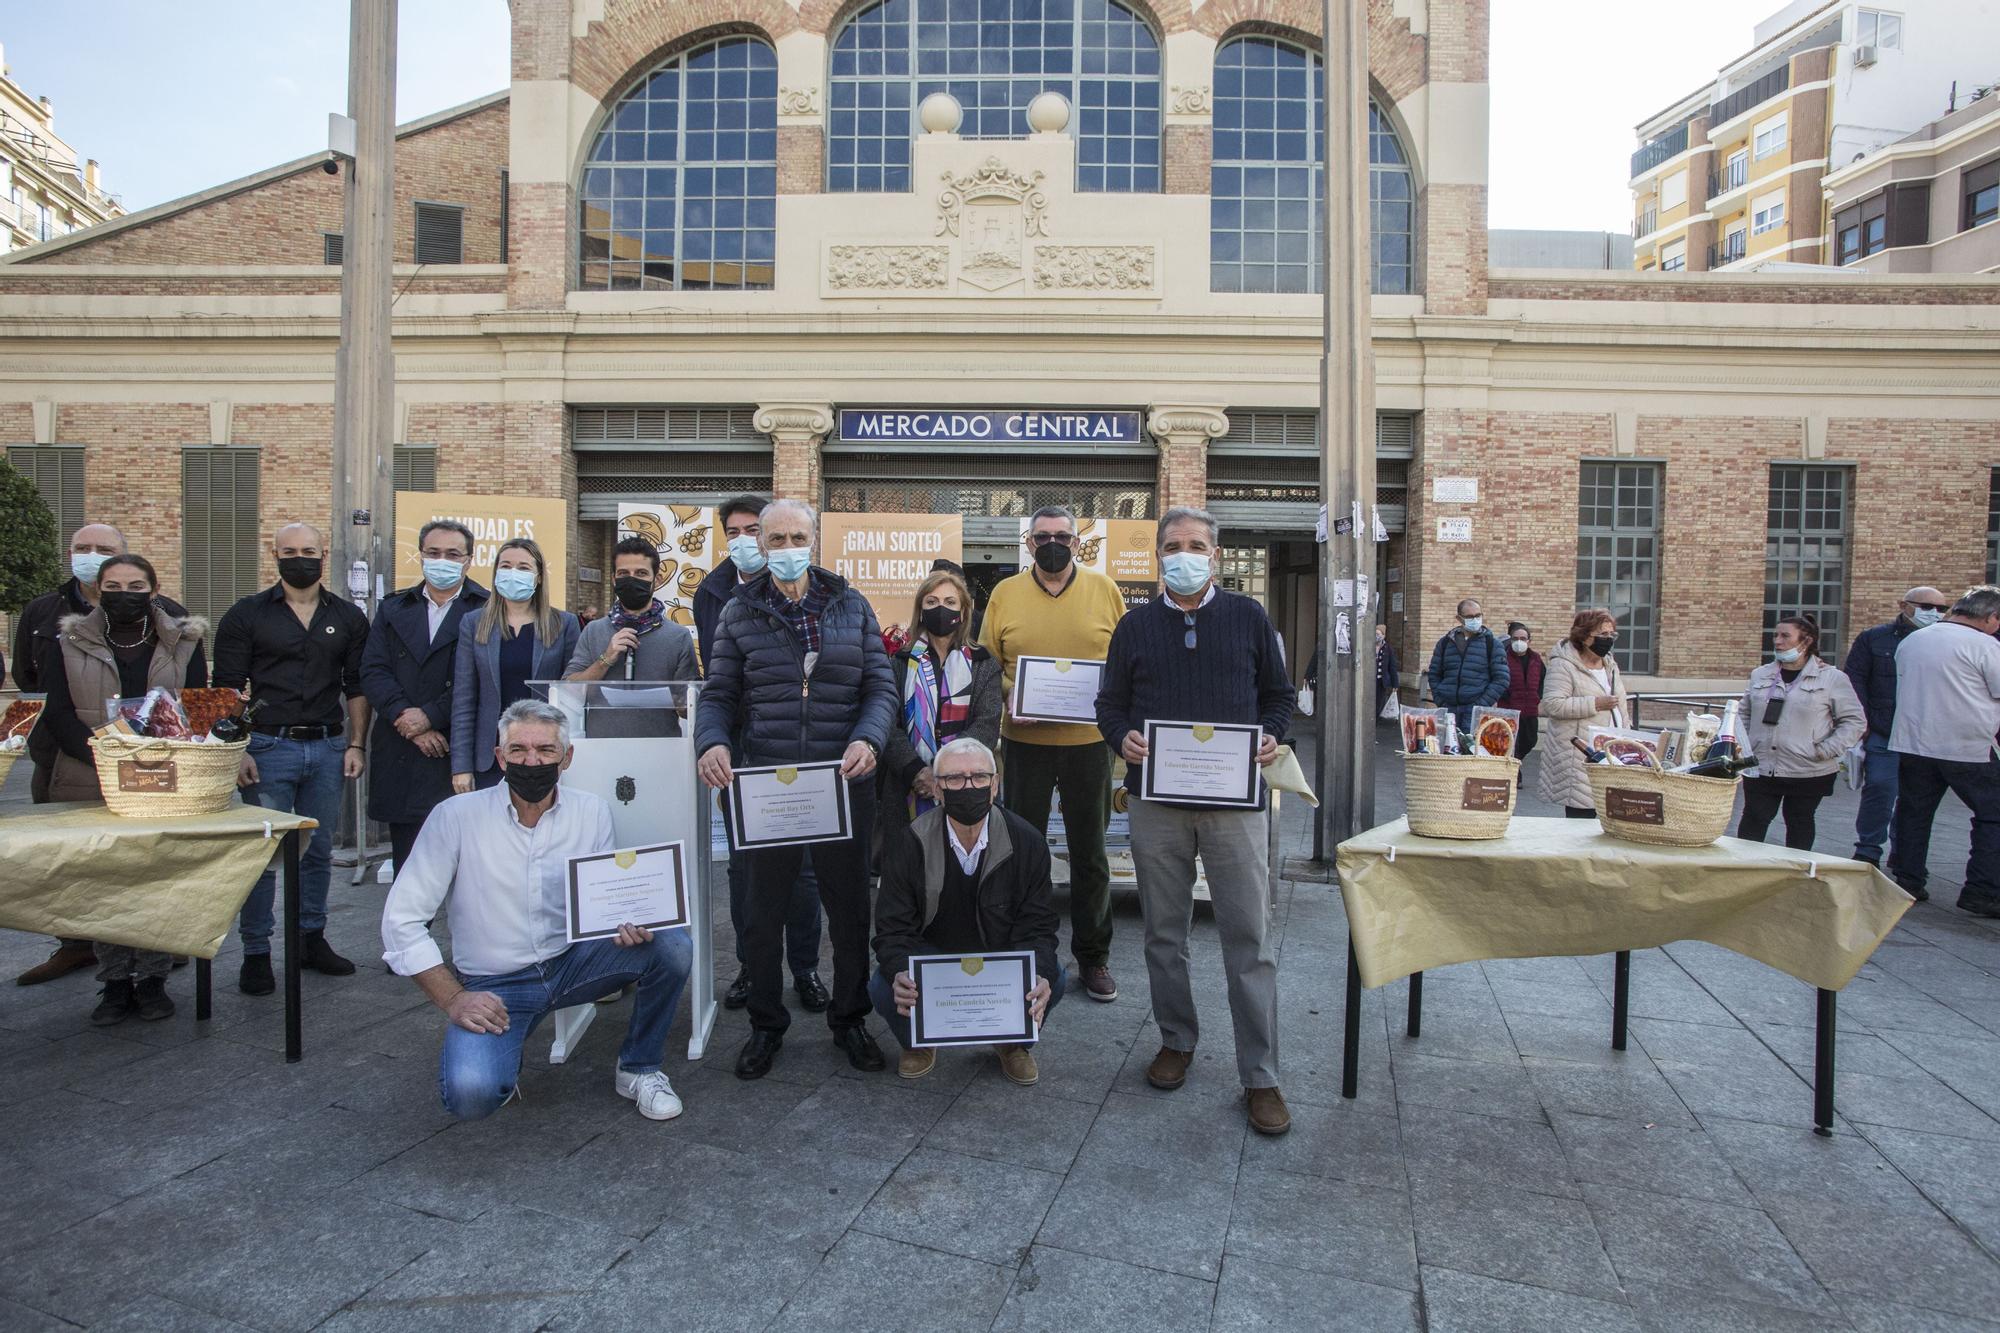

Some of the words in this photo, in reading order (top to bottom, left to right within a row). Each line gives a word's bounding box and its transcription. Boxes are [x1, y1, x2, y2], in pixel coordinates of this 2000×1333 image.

[857, 414, 991, 438] MERCADO
[1005, 415, 1124, 438] CENTRAL
[432, 515, 509, 542] VIDAD
[514, 519, 534, 541] ES
[842, 531, 886, 556] ¡GRAN
[890, 531, 942, 553] SORTEO
[1119, 550, 1150, 559] support
[1111, 559, 1129, 567] your
[835, 558, 854, 580] EN
[857, 559, 873, 580] EL
[877, 559, 935, 581] MERCAD
[1117, 567, 1150, 575] markets
[1130, 586, 1149, 596] años
[1131, 595, 1150, 604] lado
